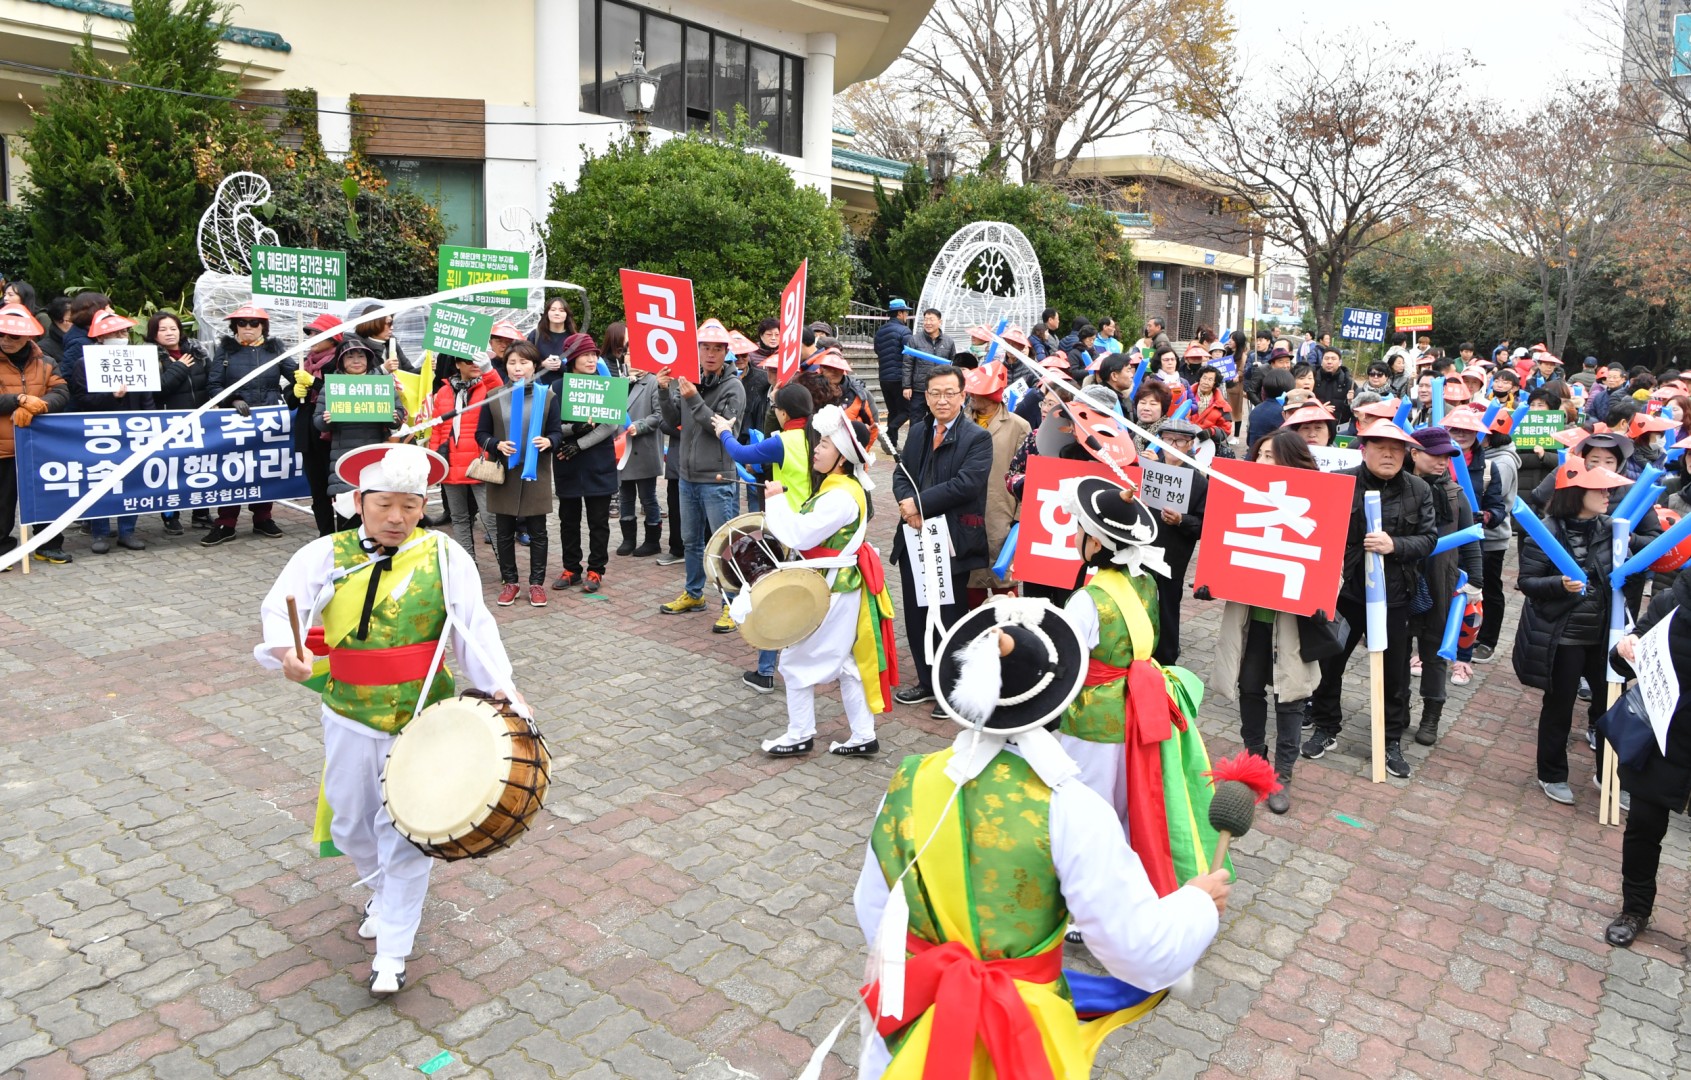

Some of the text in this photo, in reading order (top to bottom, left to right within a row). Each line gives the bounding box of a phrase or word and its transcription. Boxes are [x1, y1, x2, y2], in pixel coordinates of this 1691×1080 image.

[257, 251, 340, 277] 옛 해운대역 정거장 부지
[460, 251, 481, 260] 해운대역
[482, 253, 498, 262] 정거장
[260, 273, 336, 297] 녹색공원화 추진하라!!
[435, 308, 476, 327] 뭐라카노?
[635, 283, 685, 365] 공
[1348, 310, 1382, 327] 시민들은
[432, 321, 468, 339] 상업개발
[781, 280, 801, 375] 원
[1342, 324, 1384, 342] 숨쉬고싶다
[433, 335, 453, 350] 절대
[100, 358, 146, 372] 좋은공기
[101, 374, 148, 388] 마셔보자
[329, 382, 346, 396] 땅을
[348, 383, 372, 396] 숨쉬게
[374, 383, 391, 396] 하고
[568, 377, 610, 391] 뭐라카노?
[568, 391, 605, 405] 상업개발
[330, 401, 391, 414] 사람을 숨쉬게 하자
[572, 404, 591, 417] 절대
[83, 409, 291, 455] 공원화 추진
[1515, 437, 1537, 446] 공원화
[39, 447, 304, 498] 약속 이행하라!
[1142, 468, 1183, 489] 운대역사
[123, 485, 262, 511] 반여1동 통장협의회
